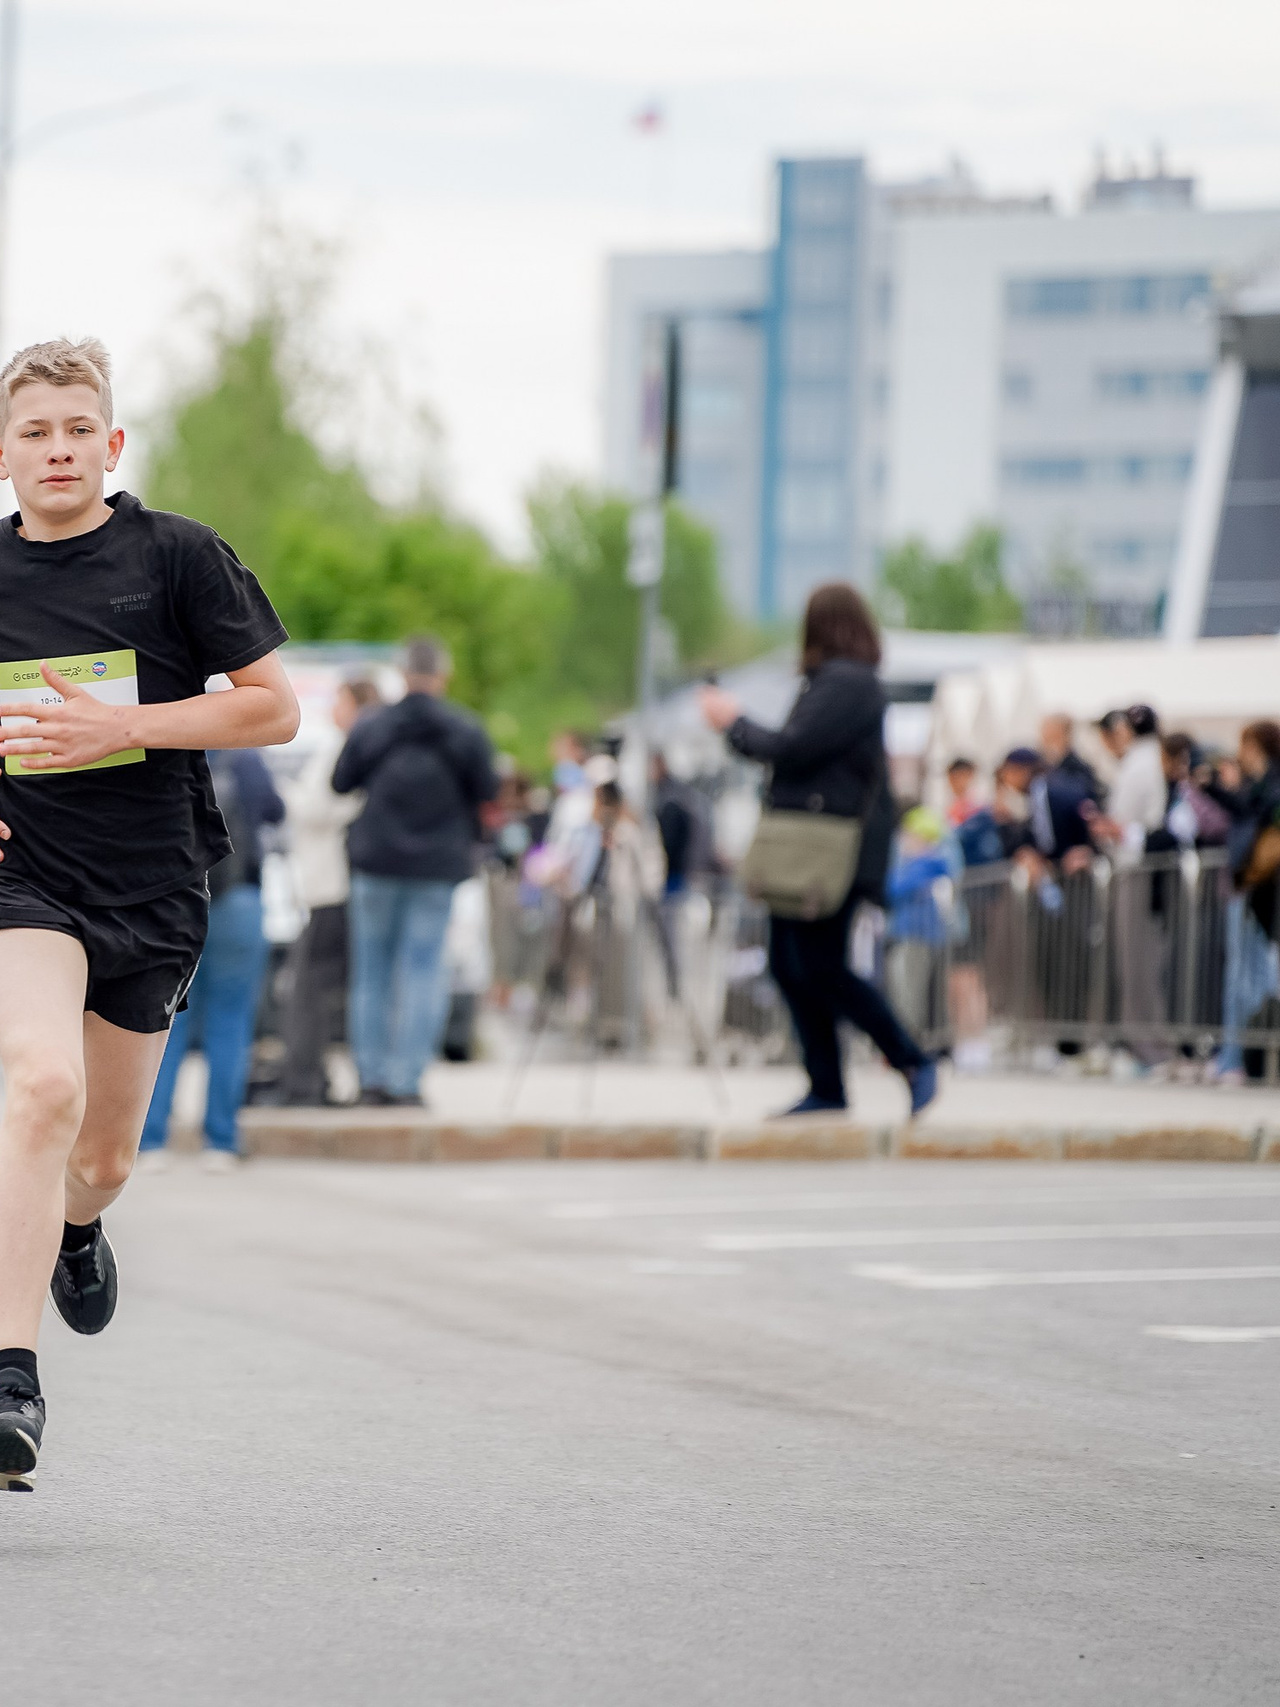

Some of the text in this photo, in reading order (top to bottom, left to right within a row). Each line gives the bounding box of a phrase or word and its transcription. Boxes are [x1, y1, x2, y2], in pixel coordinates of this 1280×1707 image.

[110, 592, 151, 604] WHATEVER
[113, 602, 148, 613] IT TAKES
[21, 672, 40, 680] СБЕР
[40, 697, 62, 705] 10-14
